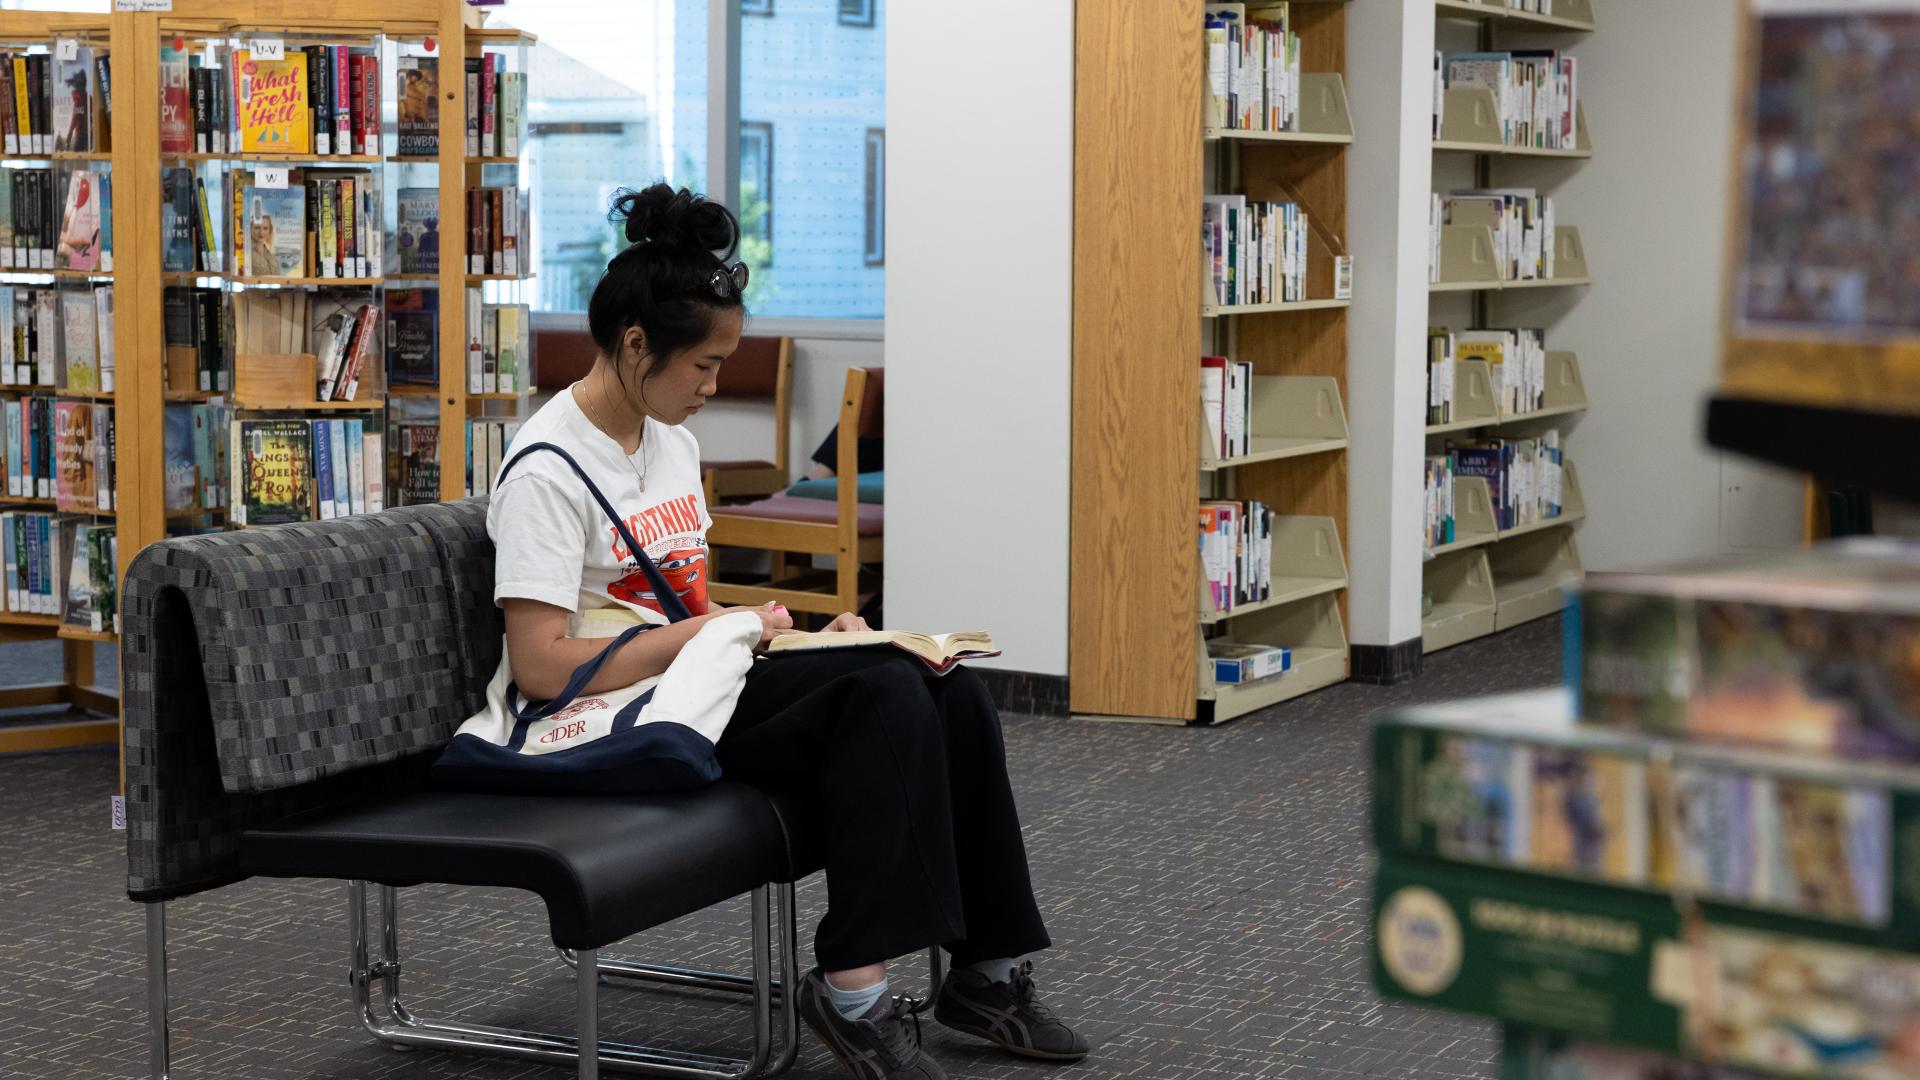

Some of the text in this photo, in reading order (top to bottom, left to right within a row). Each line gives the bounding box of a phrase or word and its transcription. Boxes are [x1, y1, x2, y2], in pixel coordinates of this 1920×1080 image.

[64, 45, 70, 54] T
[256, 45, 277, 55] U-V
[246, 85, 302, 111] Fresh
[400, 135, 439, 146] COWBOY
[266, 173, 277, 183] W
[1459, 343, 1496, 352] HARRY
[1462, 456, 1488, 465] ABBY
[409, 467, 431, 477] How
[409, 478, 426, 488] Fall
[402, 488, 440, 499] Scoundr
[540, 720, 586, 743] CIDER
